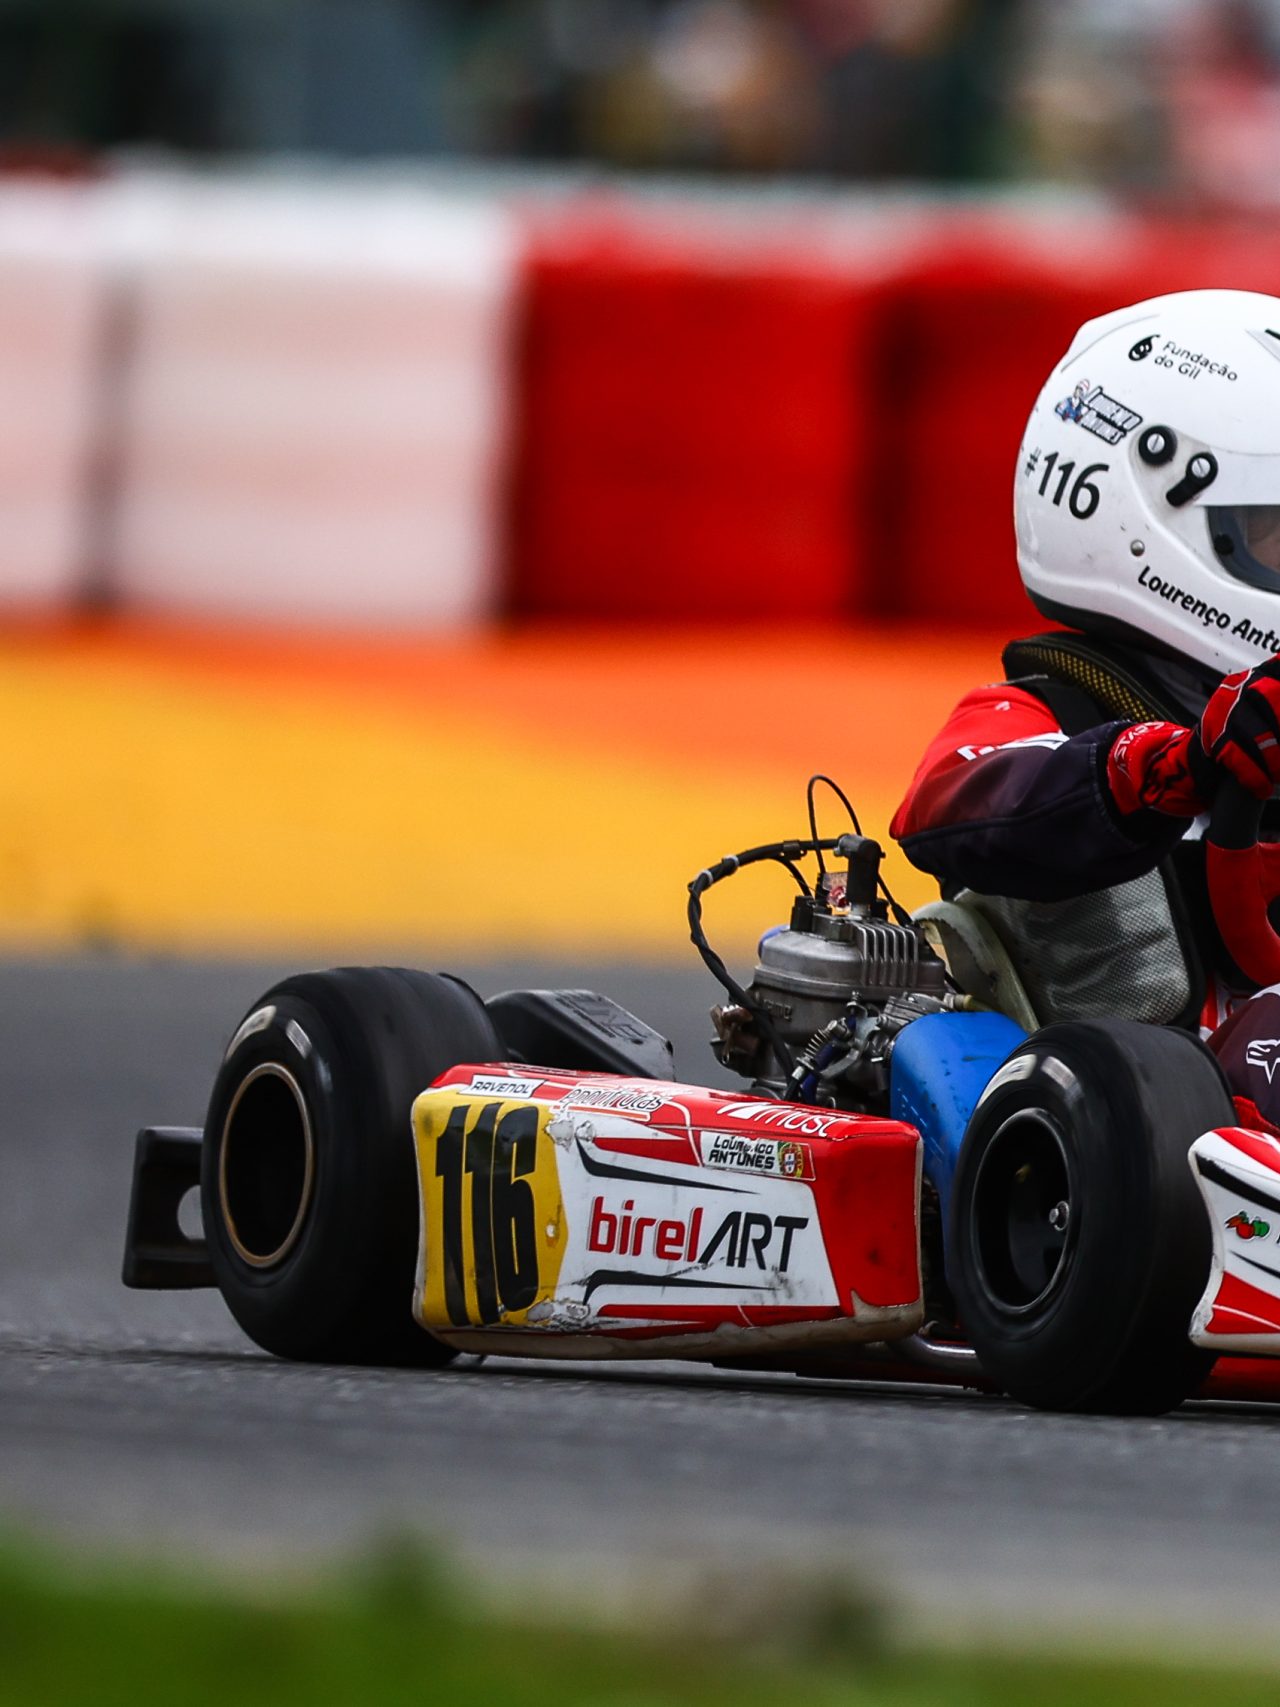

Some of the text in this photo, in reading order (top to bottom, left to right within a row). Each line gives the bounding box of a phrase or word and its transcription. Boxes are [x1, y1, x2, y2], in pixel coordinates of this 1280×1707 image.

[1154, 354, 1202, 380] do Gil
[1163, 341, 1238, 382] Fundação
[1137, 565, 1231, 627] Lourenço
[472, 1081, 531, 1095] RAVENOL
[708, 1149, 776, 1170] ANTUNES
[434, 1102, 540, 1327] 116
[587, 1196, 809, 1273] birelART
